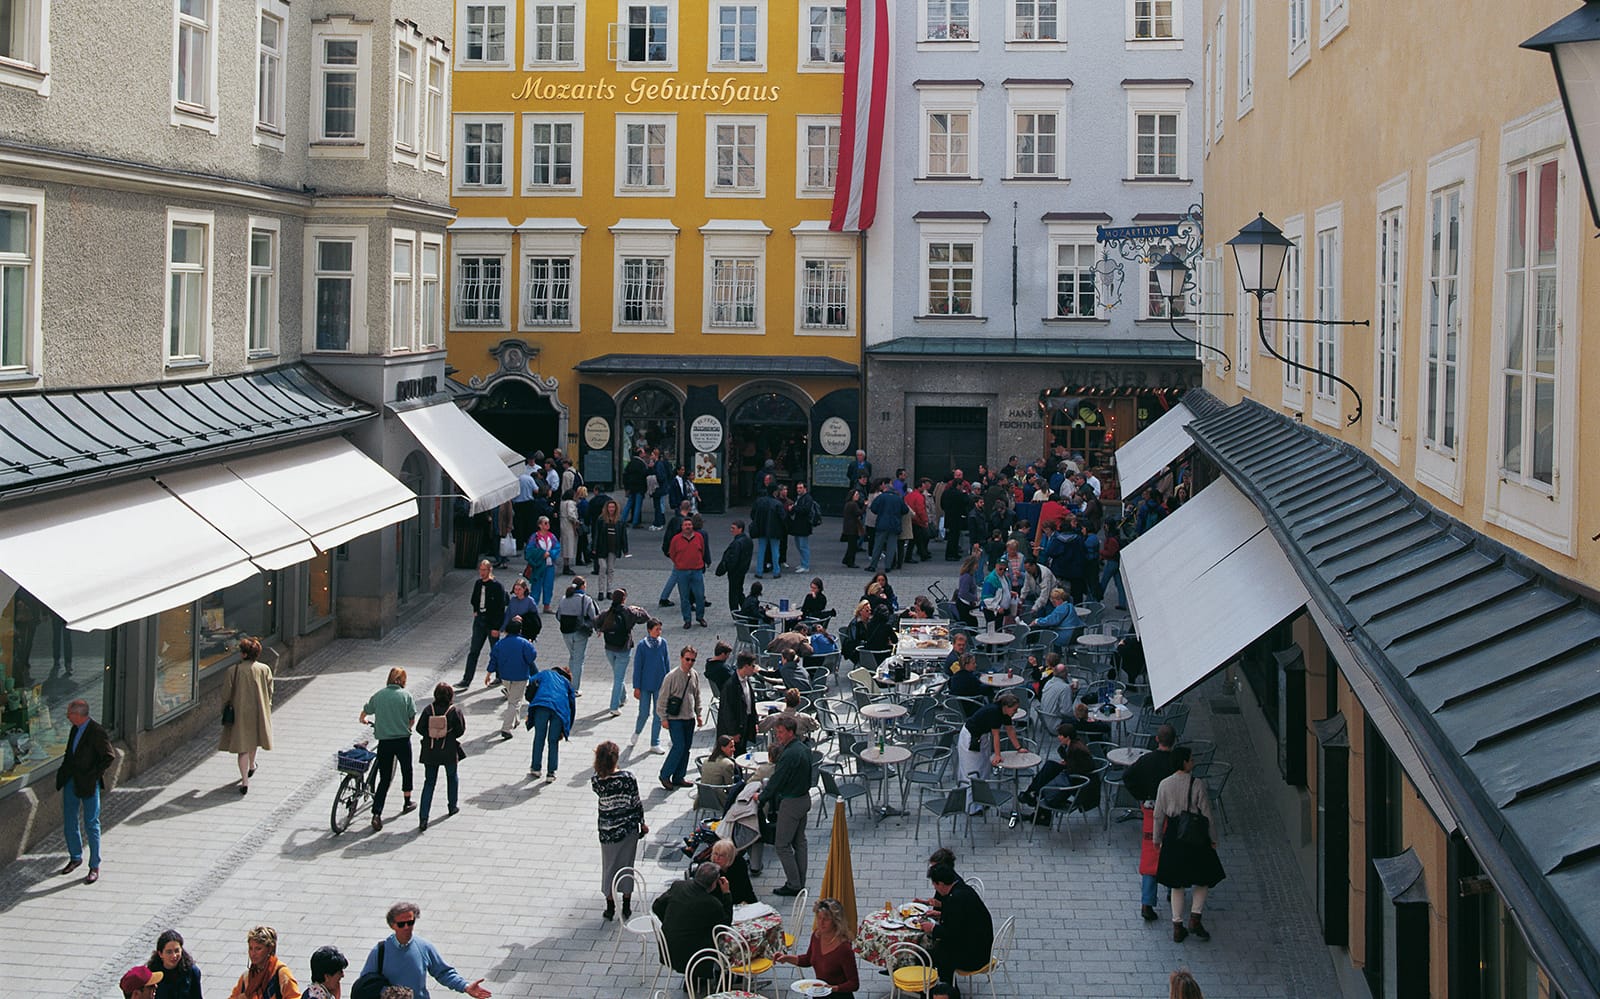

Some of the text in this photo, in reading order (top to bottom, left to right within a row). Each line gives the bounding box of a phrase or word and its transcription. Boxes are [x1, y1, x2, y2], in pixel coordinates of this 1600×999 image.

[512, 76, 780, 106] Mozarts Geburtshaus
[1105, 227, 1169, 237] MOZARTLAND
[1060, 370, 1148, 388] WIENER
[1008, 409, 1033, 418] HANS
[999, 421, 1042, 429] FEICHTNER
